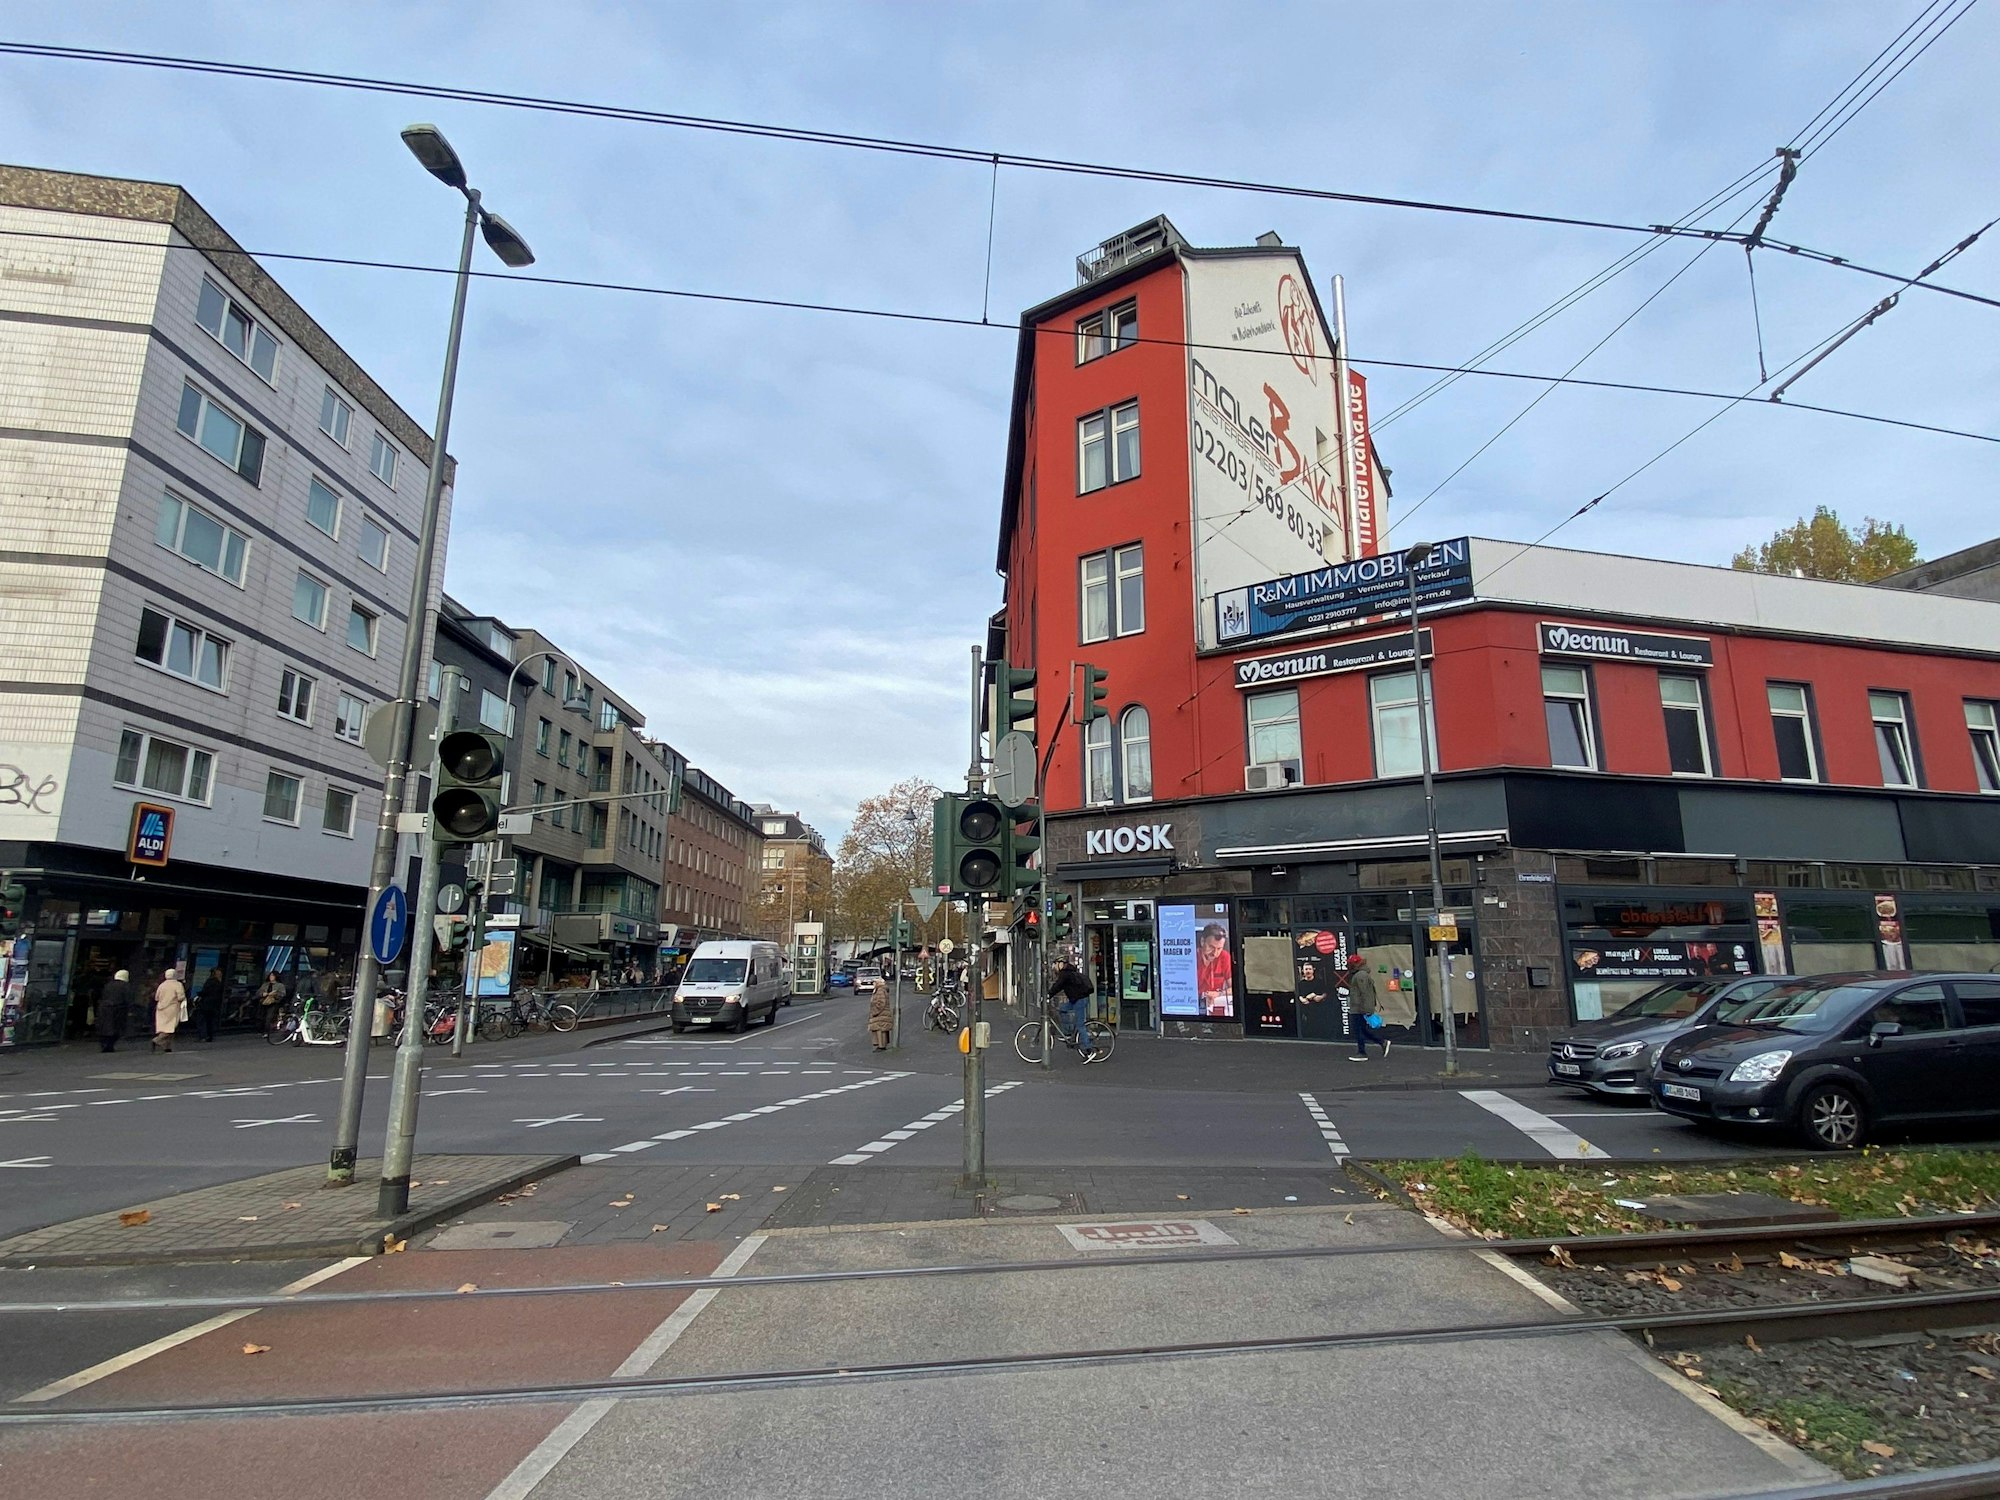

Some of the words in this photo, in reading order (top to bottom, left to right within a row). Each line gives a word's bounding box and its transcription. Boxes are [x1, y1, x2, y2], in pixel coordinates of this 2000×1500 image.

[1287, 503, 1304, 541] 80
[1307, 521, 1323, 557] 33
[1254, 581, 1297, 606] R&M
[1285, 590, 1345, 609] Hausverwaltung
[1357, 578, 1404, 595] Vermietung
[1417, 569, 1451, 582] Verkauf
[1308, 613, 1325, 623] 0221
[1374, 588, 1452, 610] info@imo-rm.de
[1548, 627, 1630, 654] Mecnun
[1634, 646, 1669, 659] Restaurant
[1671, 650, 1677, 659] &
[1679, 651, 1703, 663] Lounge
[1239, 654, 1327, 682] Mecnun
[1333, 653, 1375, 668] Restaurant
[1377, 651, 1385, 660] &
[138, 837, 164, 851] ALDI
[1086, 823, 1175, 855] KIOSK
[803, 947, 811, 956] U
[1163, 948, 1183, 956] MAGEN
[1184, 947, 1192, 955] OP
[1604, 948, 1633, 962] mangal
